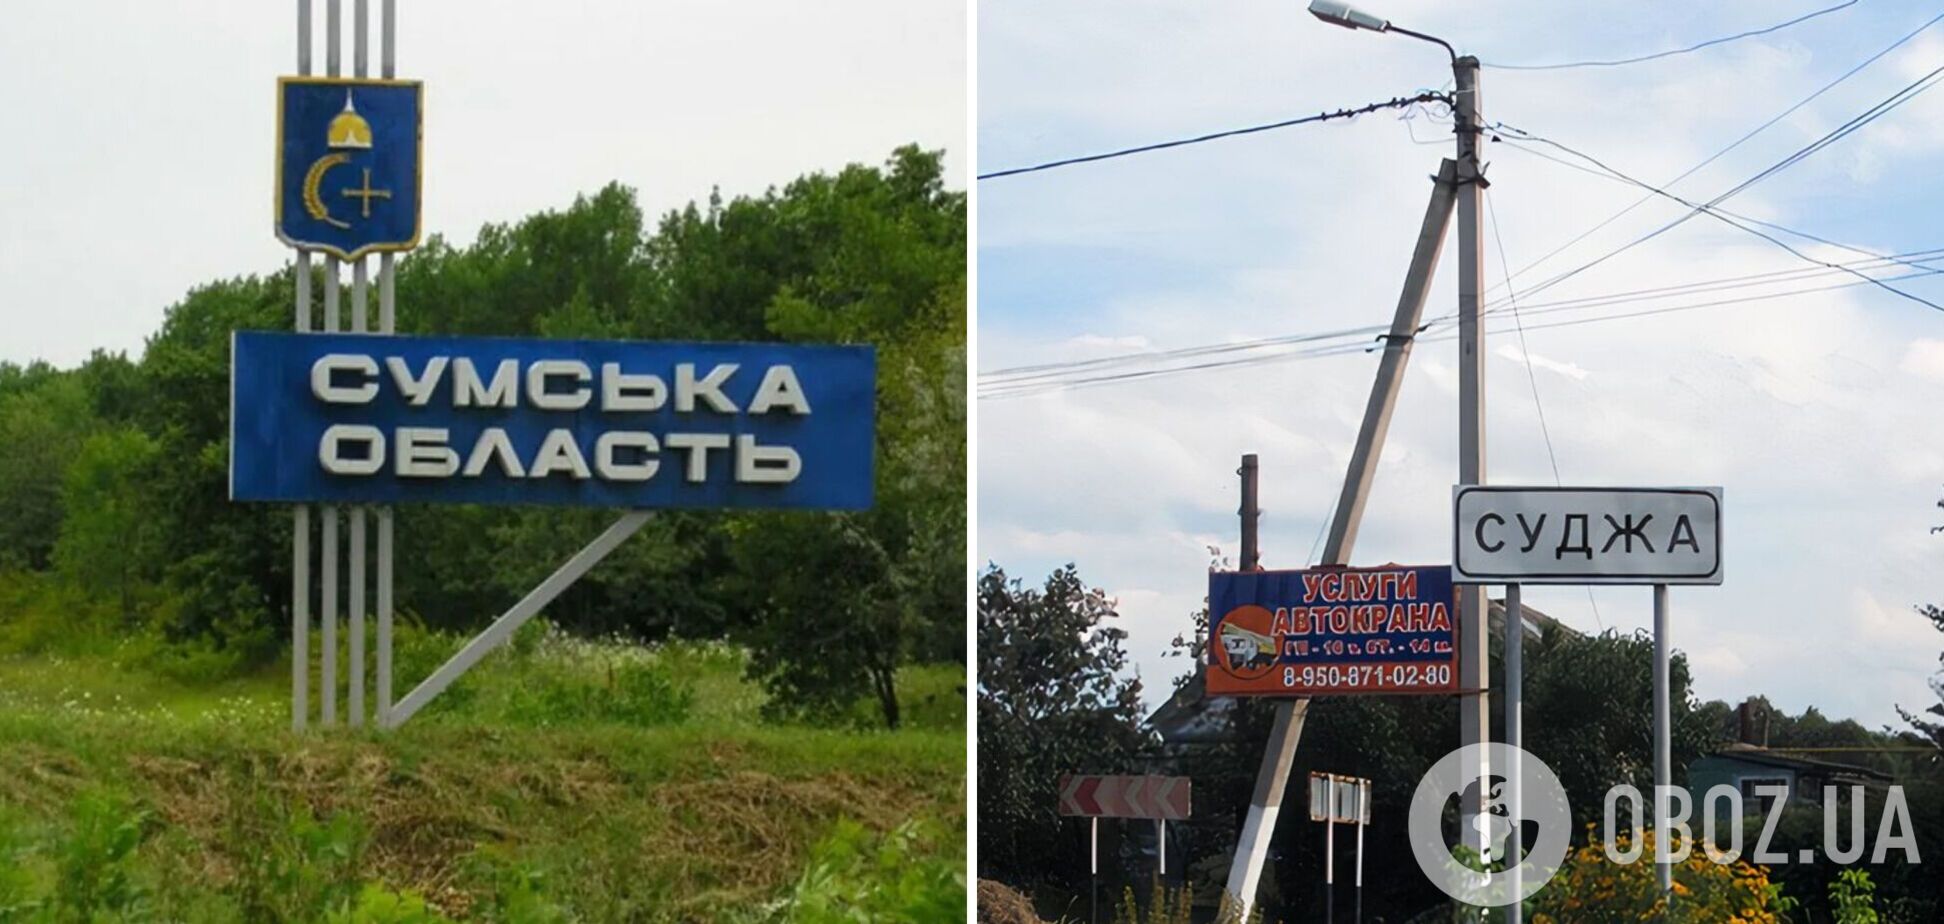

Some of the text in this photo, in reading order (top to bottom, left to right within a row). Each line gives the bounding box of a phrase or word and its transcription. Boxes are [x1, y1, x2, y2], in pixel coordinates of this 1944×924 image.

[311, 354, 812, 415] СУМСЬКА
[318, 423, 803, 483] ОБЛАСТЬ
[1475, 513, 1700, 560] СУДЖА
[1302, 570, 1418, 603] УСЛУГИ
[1271, 602, 1452, 637] АВТОКРАНА
[1284, 665, 1451, 687] 8-950-871-02-80
